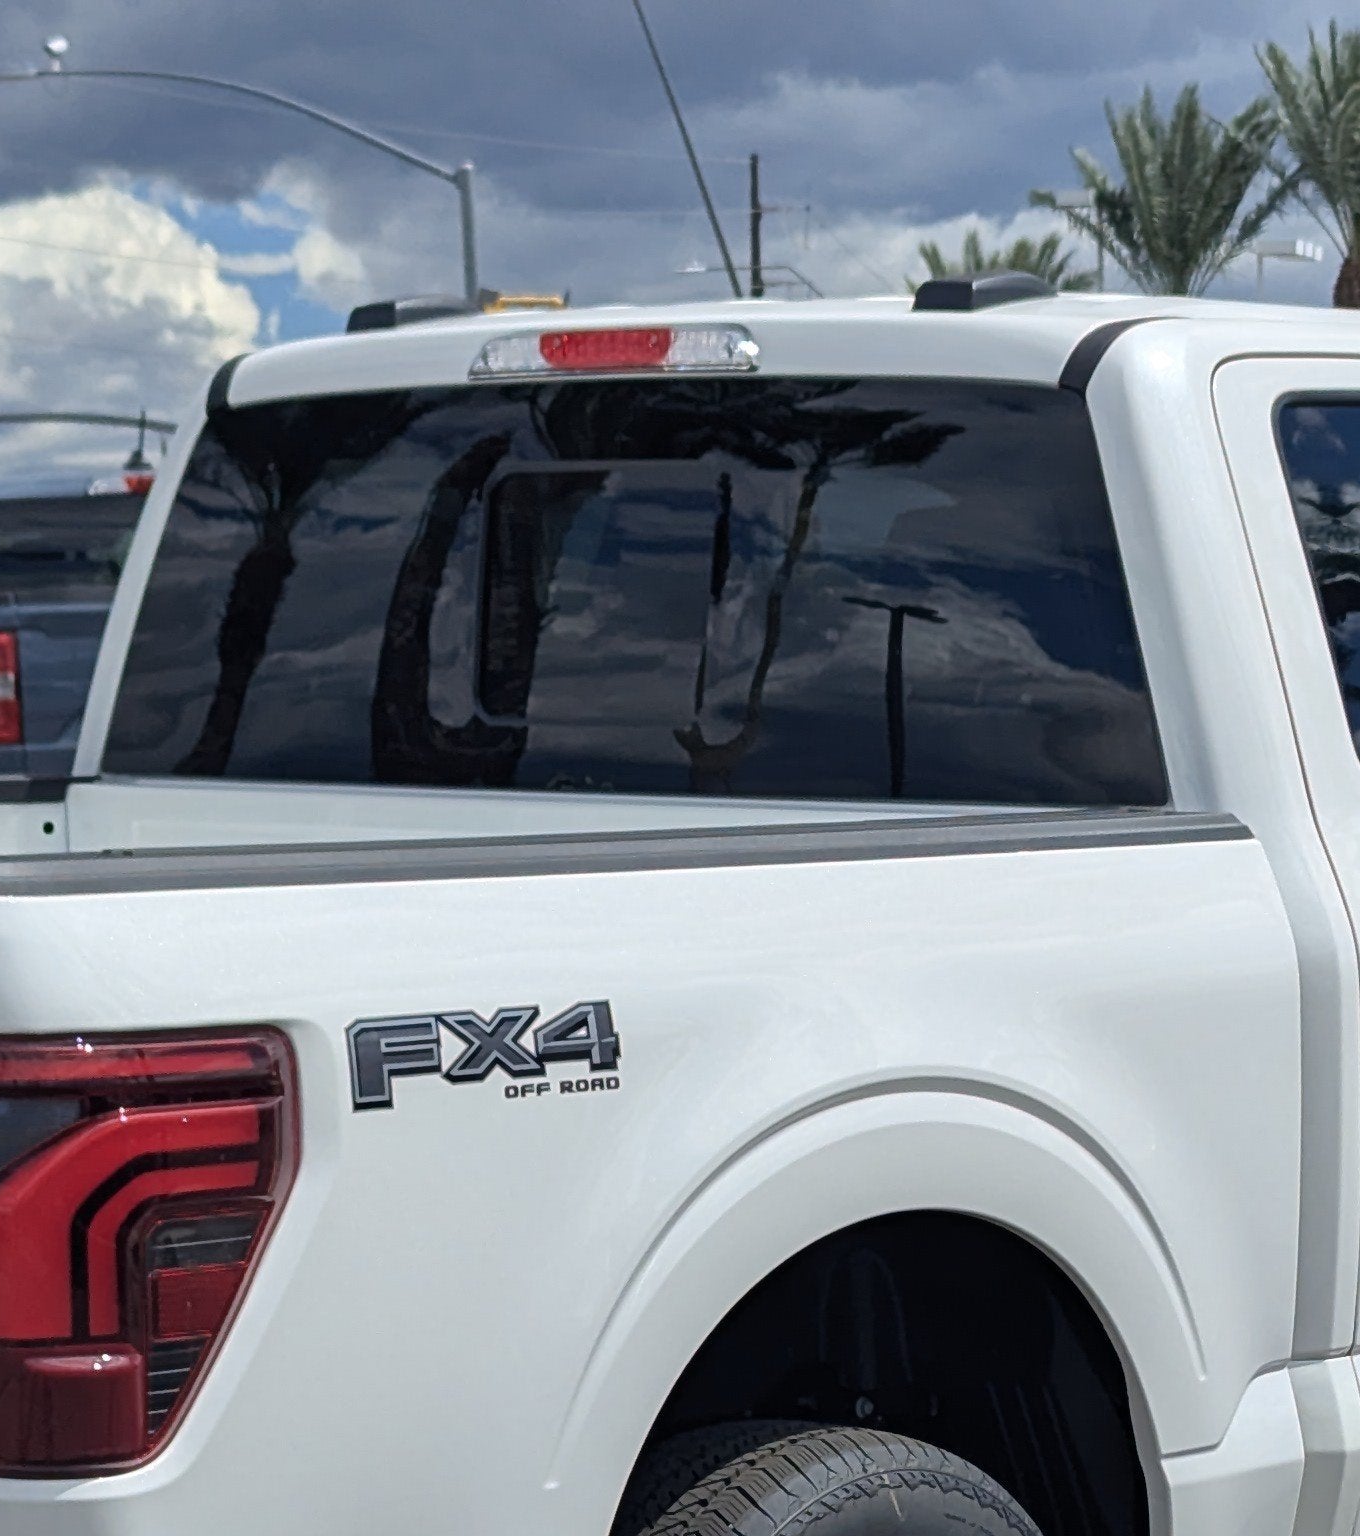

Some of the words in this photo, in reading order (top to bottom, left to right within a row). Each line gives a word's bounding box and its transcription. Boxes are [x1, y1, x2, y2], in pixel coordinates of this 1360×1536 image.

[343, 998, 622, 1113] FX4
[503, 1081, 552, 1099] OFF
[558, 1075, 621, 1095] ROAD
